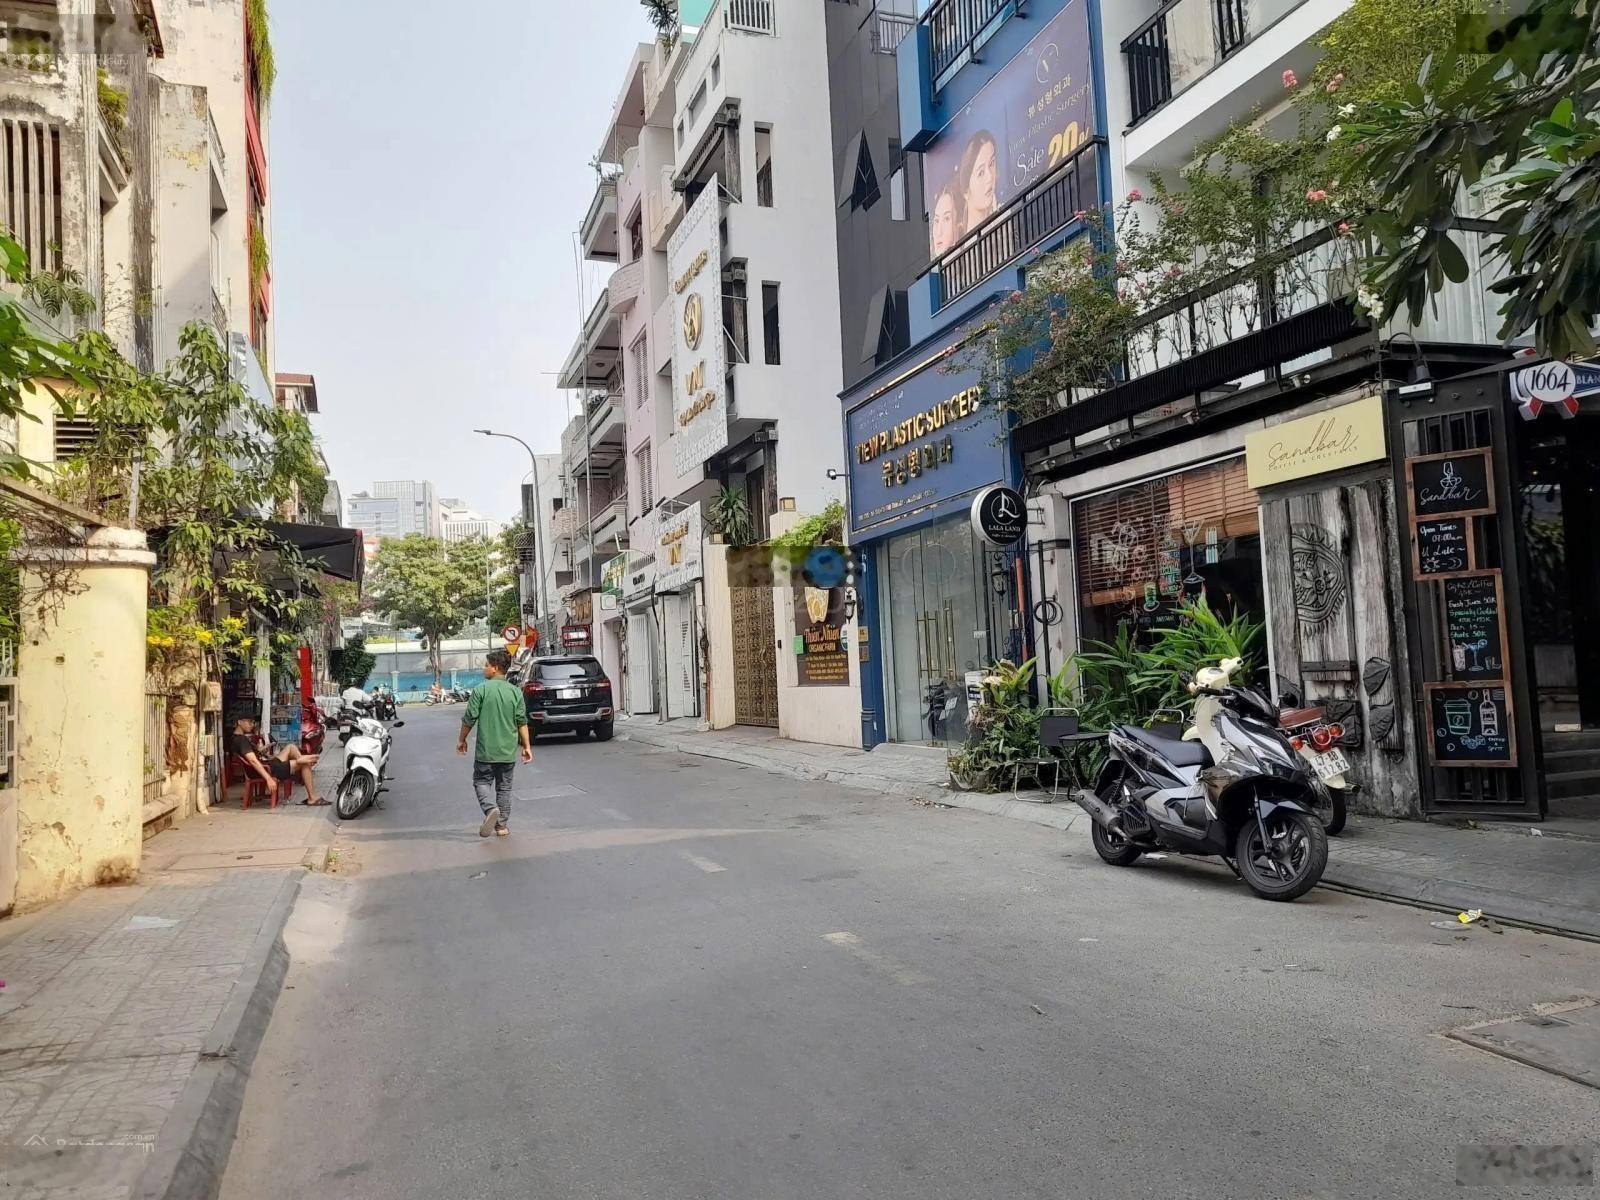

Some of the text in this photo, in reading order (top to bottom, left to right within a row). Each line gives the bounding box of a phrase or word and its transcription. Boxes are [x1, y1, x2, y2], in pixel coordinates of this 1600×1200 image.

[1013, 148, 1044, 186] Sale
[1531, 365, 1571, 393] 1664
[879, 412, 924, 452] PLASTIC
[1266, 416, 1360, 466] Sandbar
[1420, 486, 1481, 506] Sandbar
